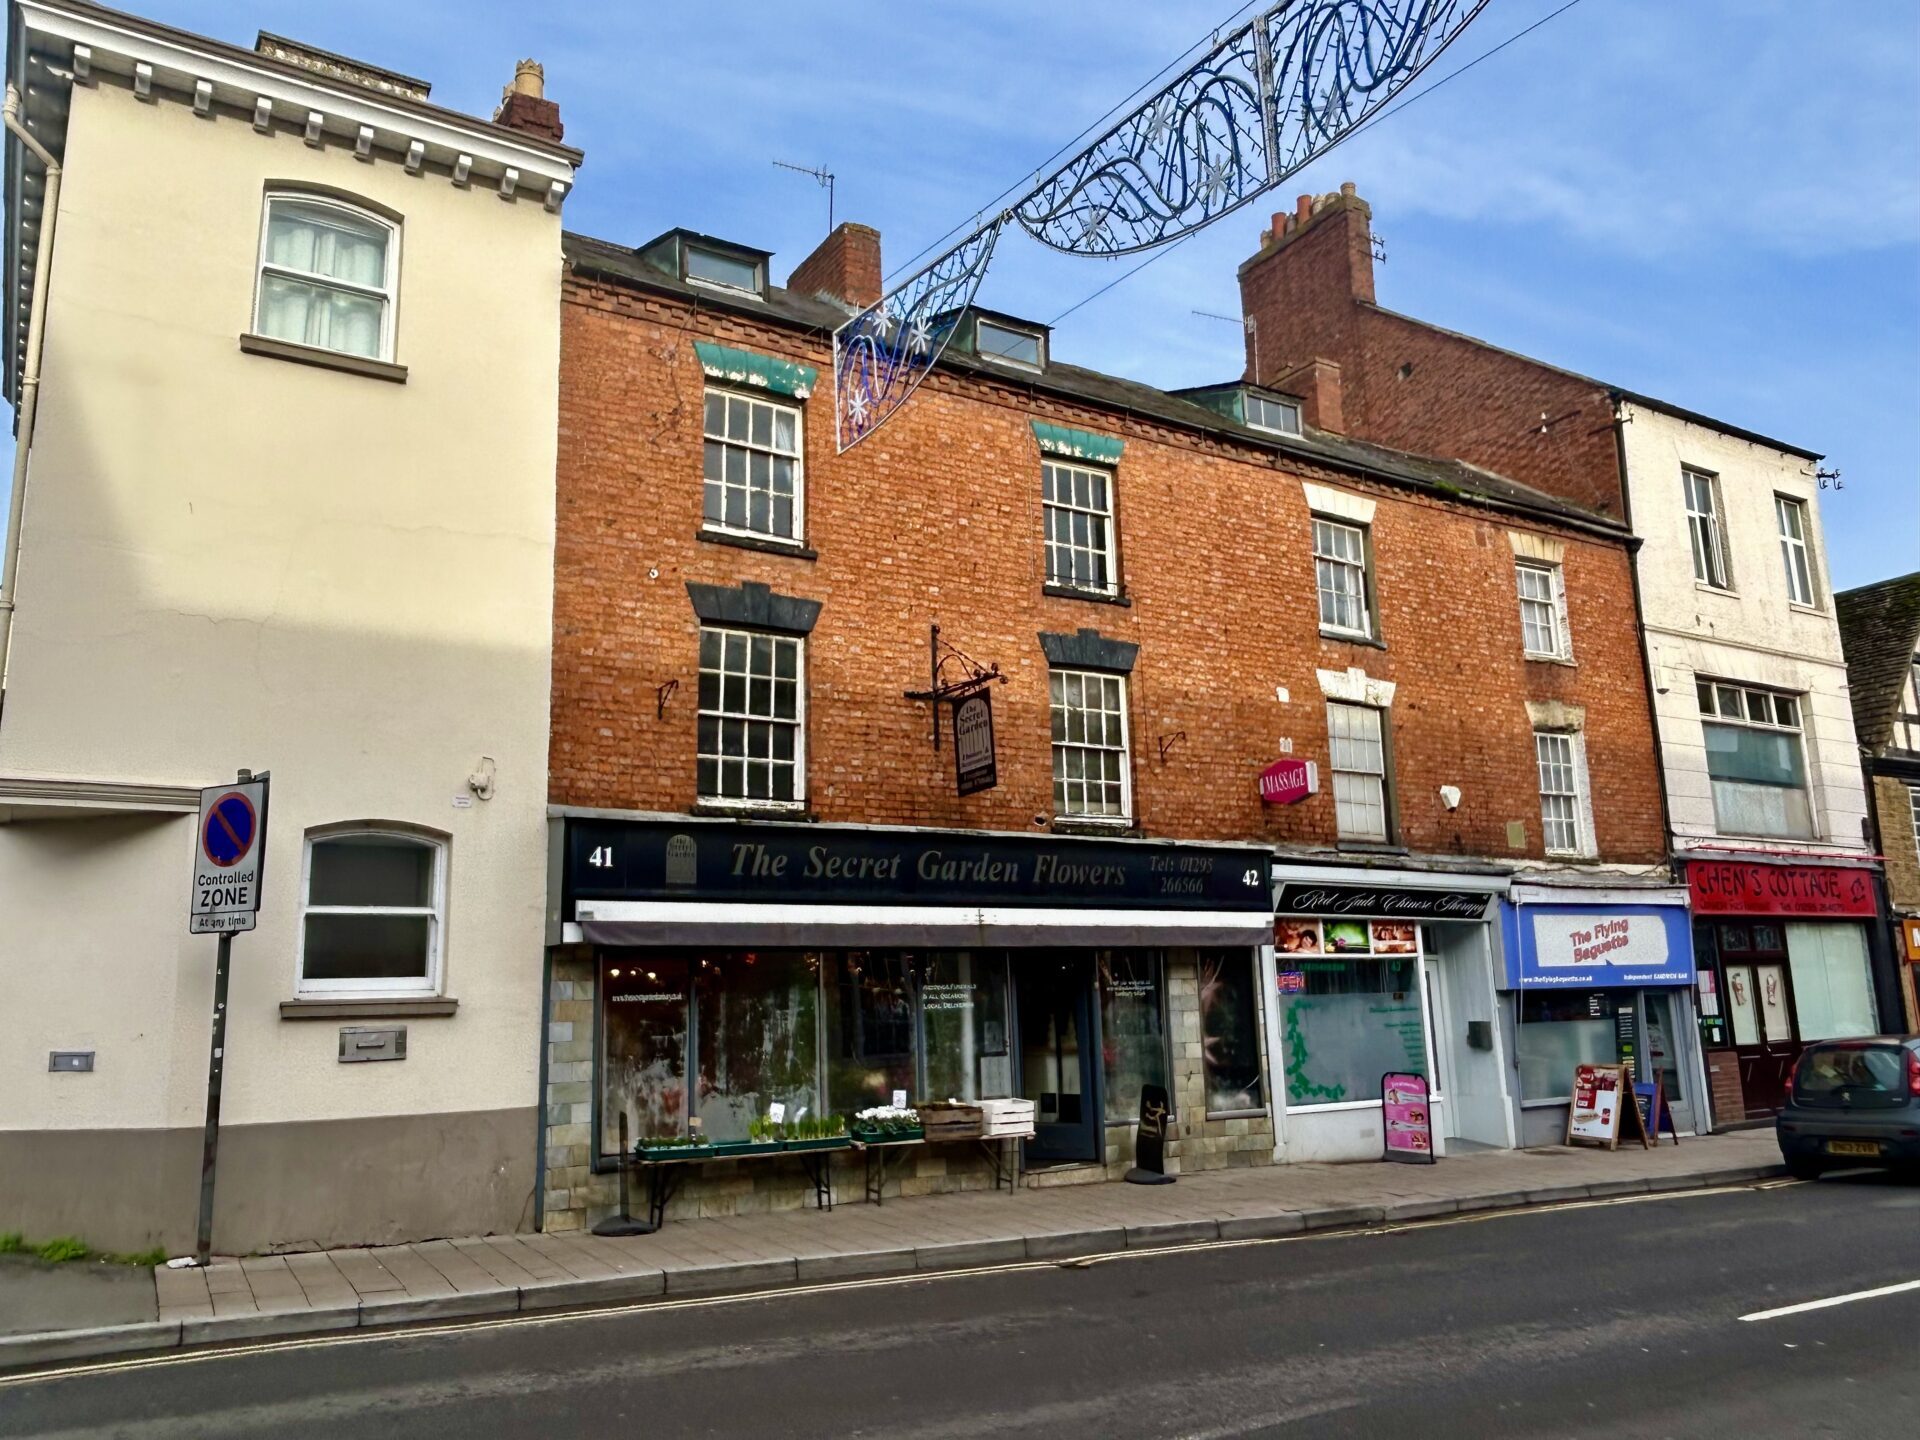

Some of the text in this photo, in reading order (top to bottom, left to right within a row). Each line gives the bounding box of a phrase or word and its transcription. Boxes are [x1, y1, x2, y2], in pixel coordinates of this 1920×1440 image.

[959, 720, 988, 736] Garden
[1265, 767, 1305, 793] MASSAGE
[589, 845, 613, 868] 41
[731, 843, 1126, 886] The Secret Garden Flowers
[1150, 855, 1214, 875] Tel: 01295
[198, 869, 254, 886] Controlled
[1160, 876, 1204, 895] 266566
[1242, 869, 1260, 887] 42
[1696, 864, 1842, 900] CHEN'S COTTAGE
[201, 887, 248, 907] ZONE
[1292, 889, 1337, 910] Red
[1380, 894, 1432, 912] Chinese
[1434, 894, 1488, 917] Therapy
[199, 915, 246, 928] At any time
[1569, 918, 1628, 947] The Flying
[1573, 934, 1629, 963] Baguette
